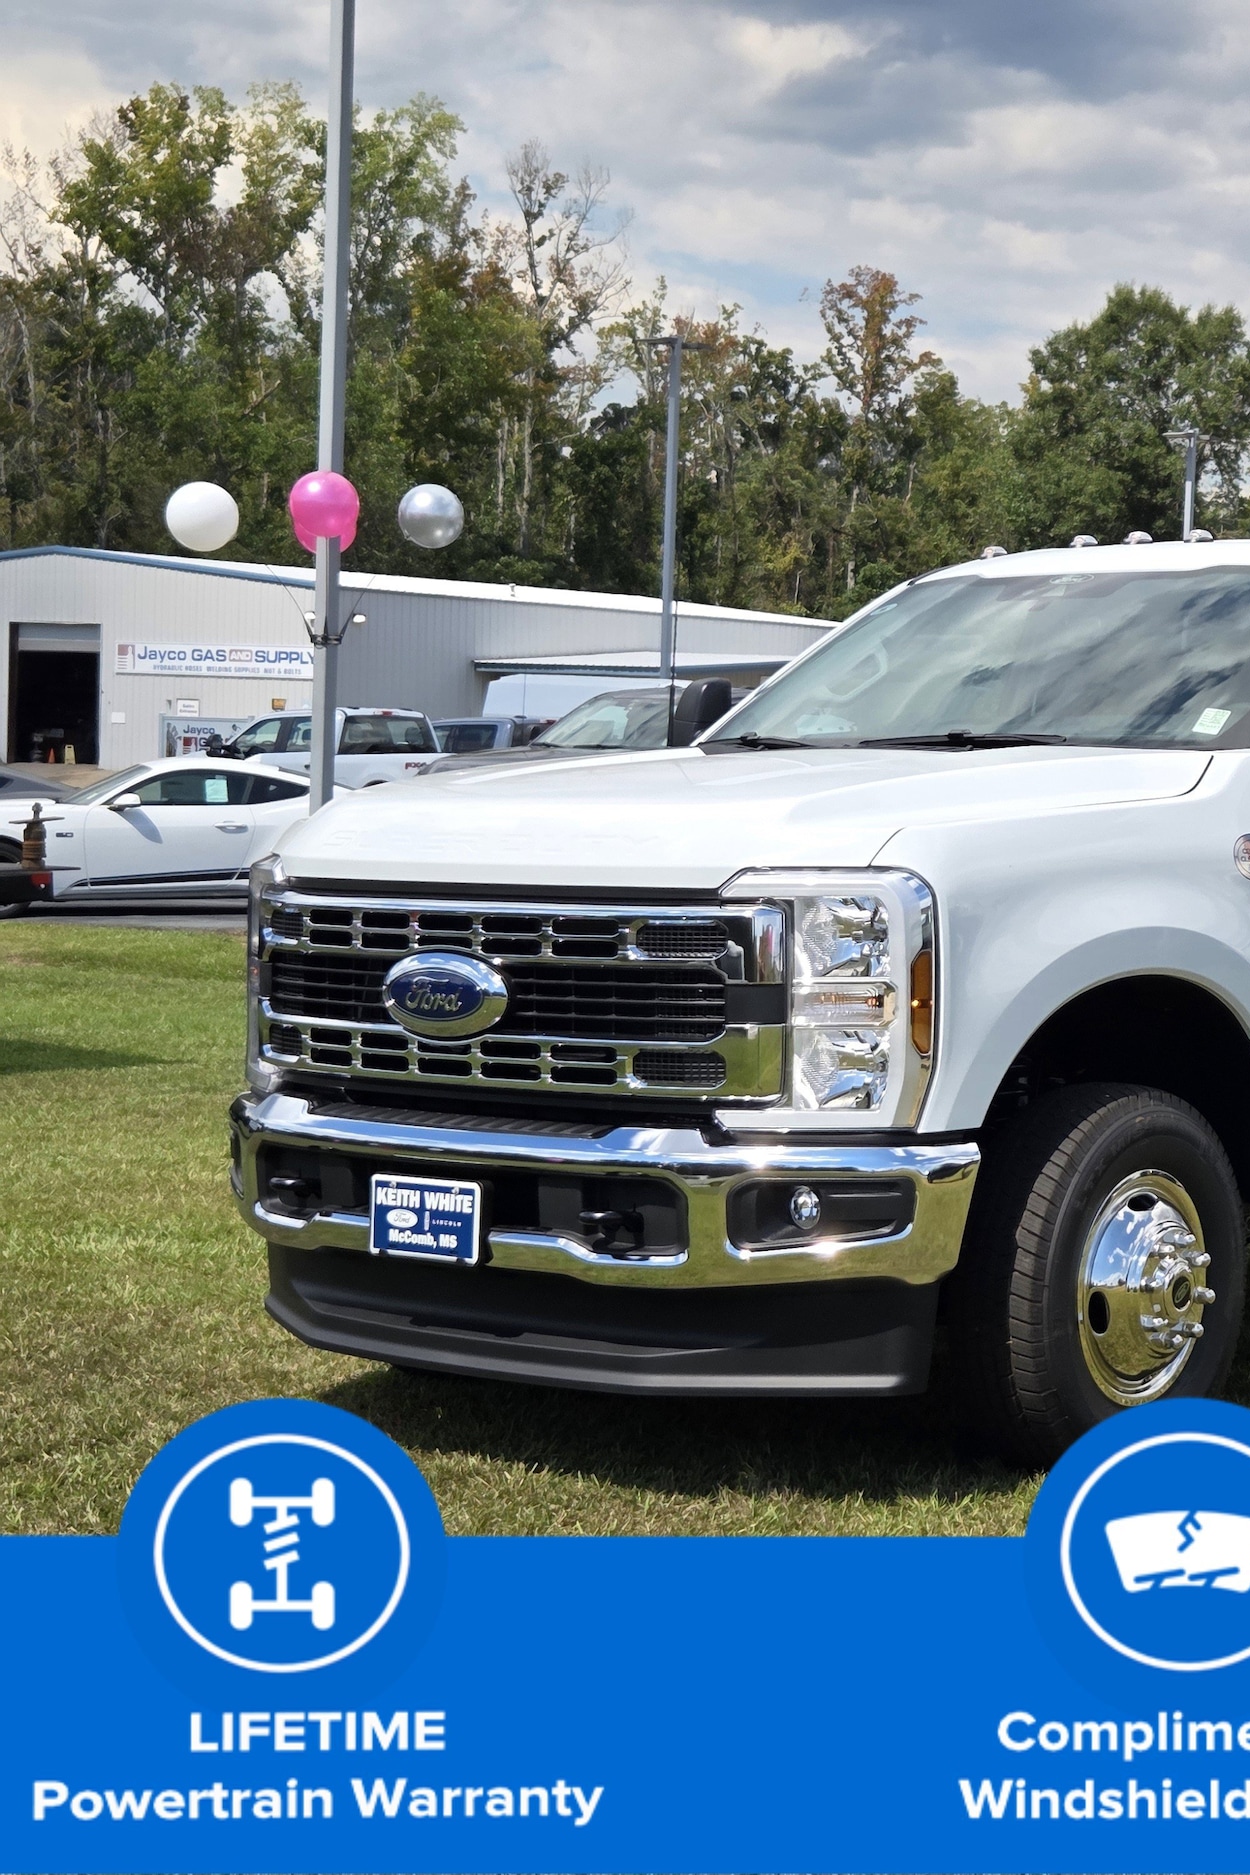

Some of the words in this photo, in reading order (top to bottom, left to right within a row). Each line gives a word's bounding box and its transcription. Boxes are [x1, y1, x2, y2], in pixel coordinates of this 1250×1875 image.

[137, 646, 187, 663] Jayco
[191, 649, 227, 662] GAS
[230, 650, 252, 662] AND
[153, 664, 183, 672] HYDRAULIC
[183, 725, 215, 736] Jayco
[405, 976, 463, 1012] Ford
[376, 1186, 421, 1208] KEITH
[423, 1191, 474, 1213] WHITE
[432, 1218, 462, 1227] LINCOLN
[389, 1229, 438, 1249] McComb,
[439, 1234, 458, 1249] MS
